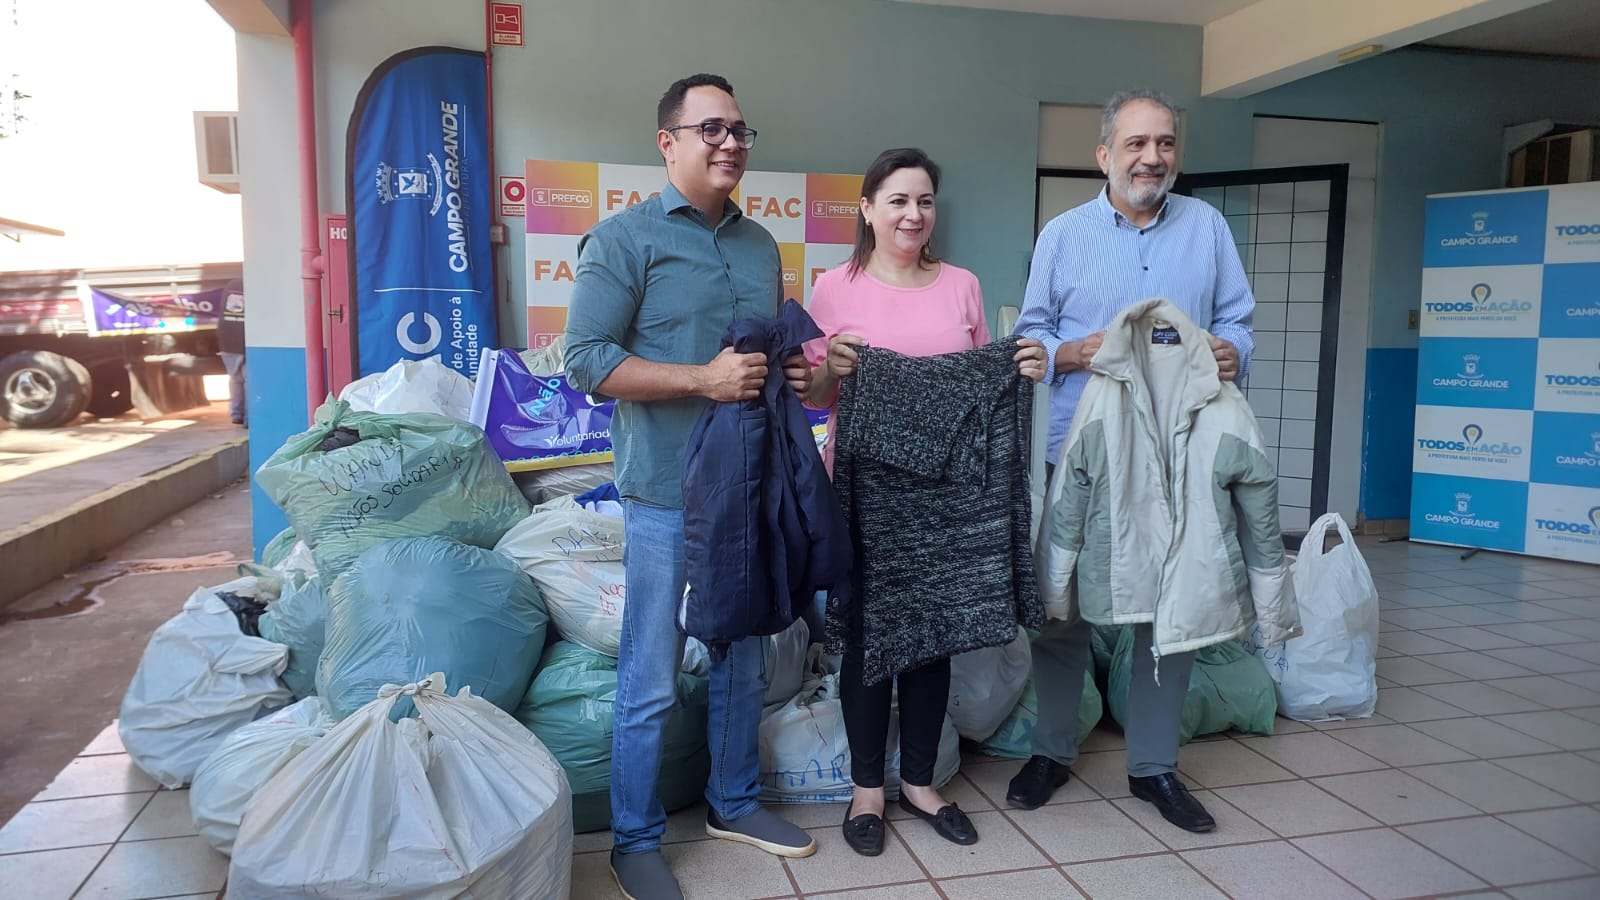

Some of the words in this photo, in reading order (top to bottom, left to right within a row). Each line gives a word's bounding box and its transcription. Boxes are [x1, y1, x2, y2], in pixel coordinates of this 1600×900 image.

[441, 101, 461, 189] GRANDE
[551, 193, 590, 203] PREFCG
[607, 189, 660, 211] FA
[746, 196, 802, 218] FAC
[445, 192, 468, 272] CAMPO
[1555, 224, 1600, 236] TODO
[1441, 237, 1476, 247] CAMPO
[1477, 235, 1518, 245] GRANDE
[534, 260, 575, 281] FA
[449, 296, 462, 305] à
[1425, 302, 1473, 312] TODOS
[1487, 299, 1532, 313] AÇÃO
[1566, 308, 1600, 317] CAMP
[449, 308, 465, 353] Apoio
[465, 324, 479, 381] unidade
[451, 354, 464, 369] de
[1433, 378, 1467, 387] CAMPO
[1468, 379, 1509, 389] GRANDE
[1545, 374, 1600, 387] TODOS
[529, 378, 561, 416] Não
[544, 428, 610, 448] Voluntariad
[1417, 439, 1465, 451] TODOS
[1480, 442, 1522, 455] AÇÃO
[1556, 455, 1596, 466] CAMPO
[1425, 513, 1459, 525] CAMPO
[1460, 516, 1500, 529] GRANDE
[1535, 519, 1591, 535] TODOS
